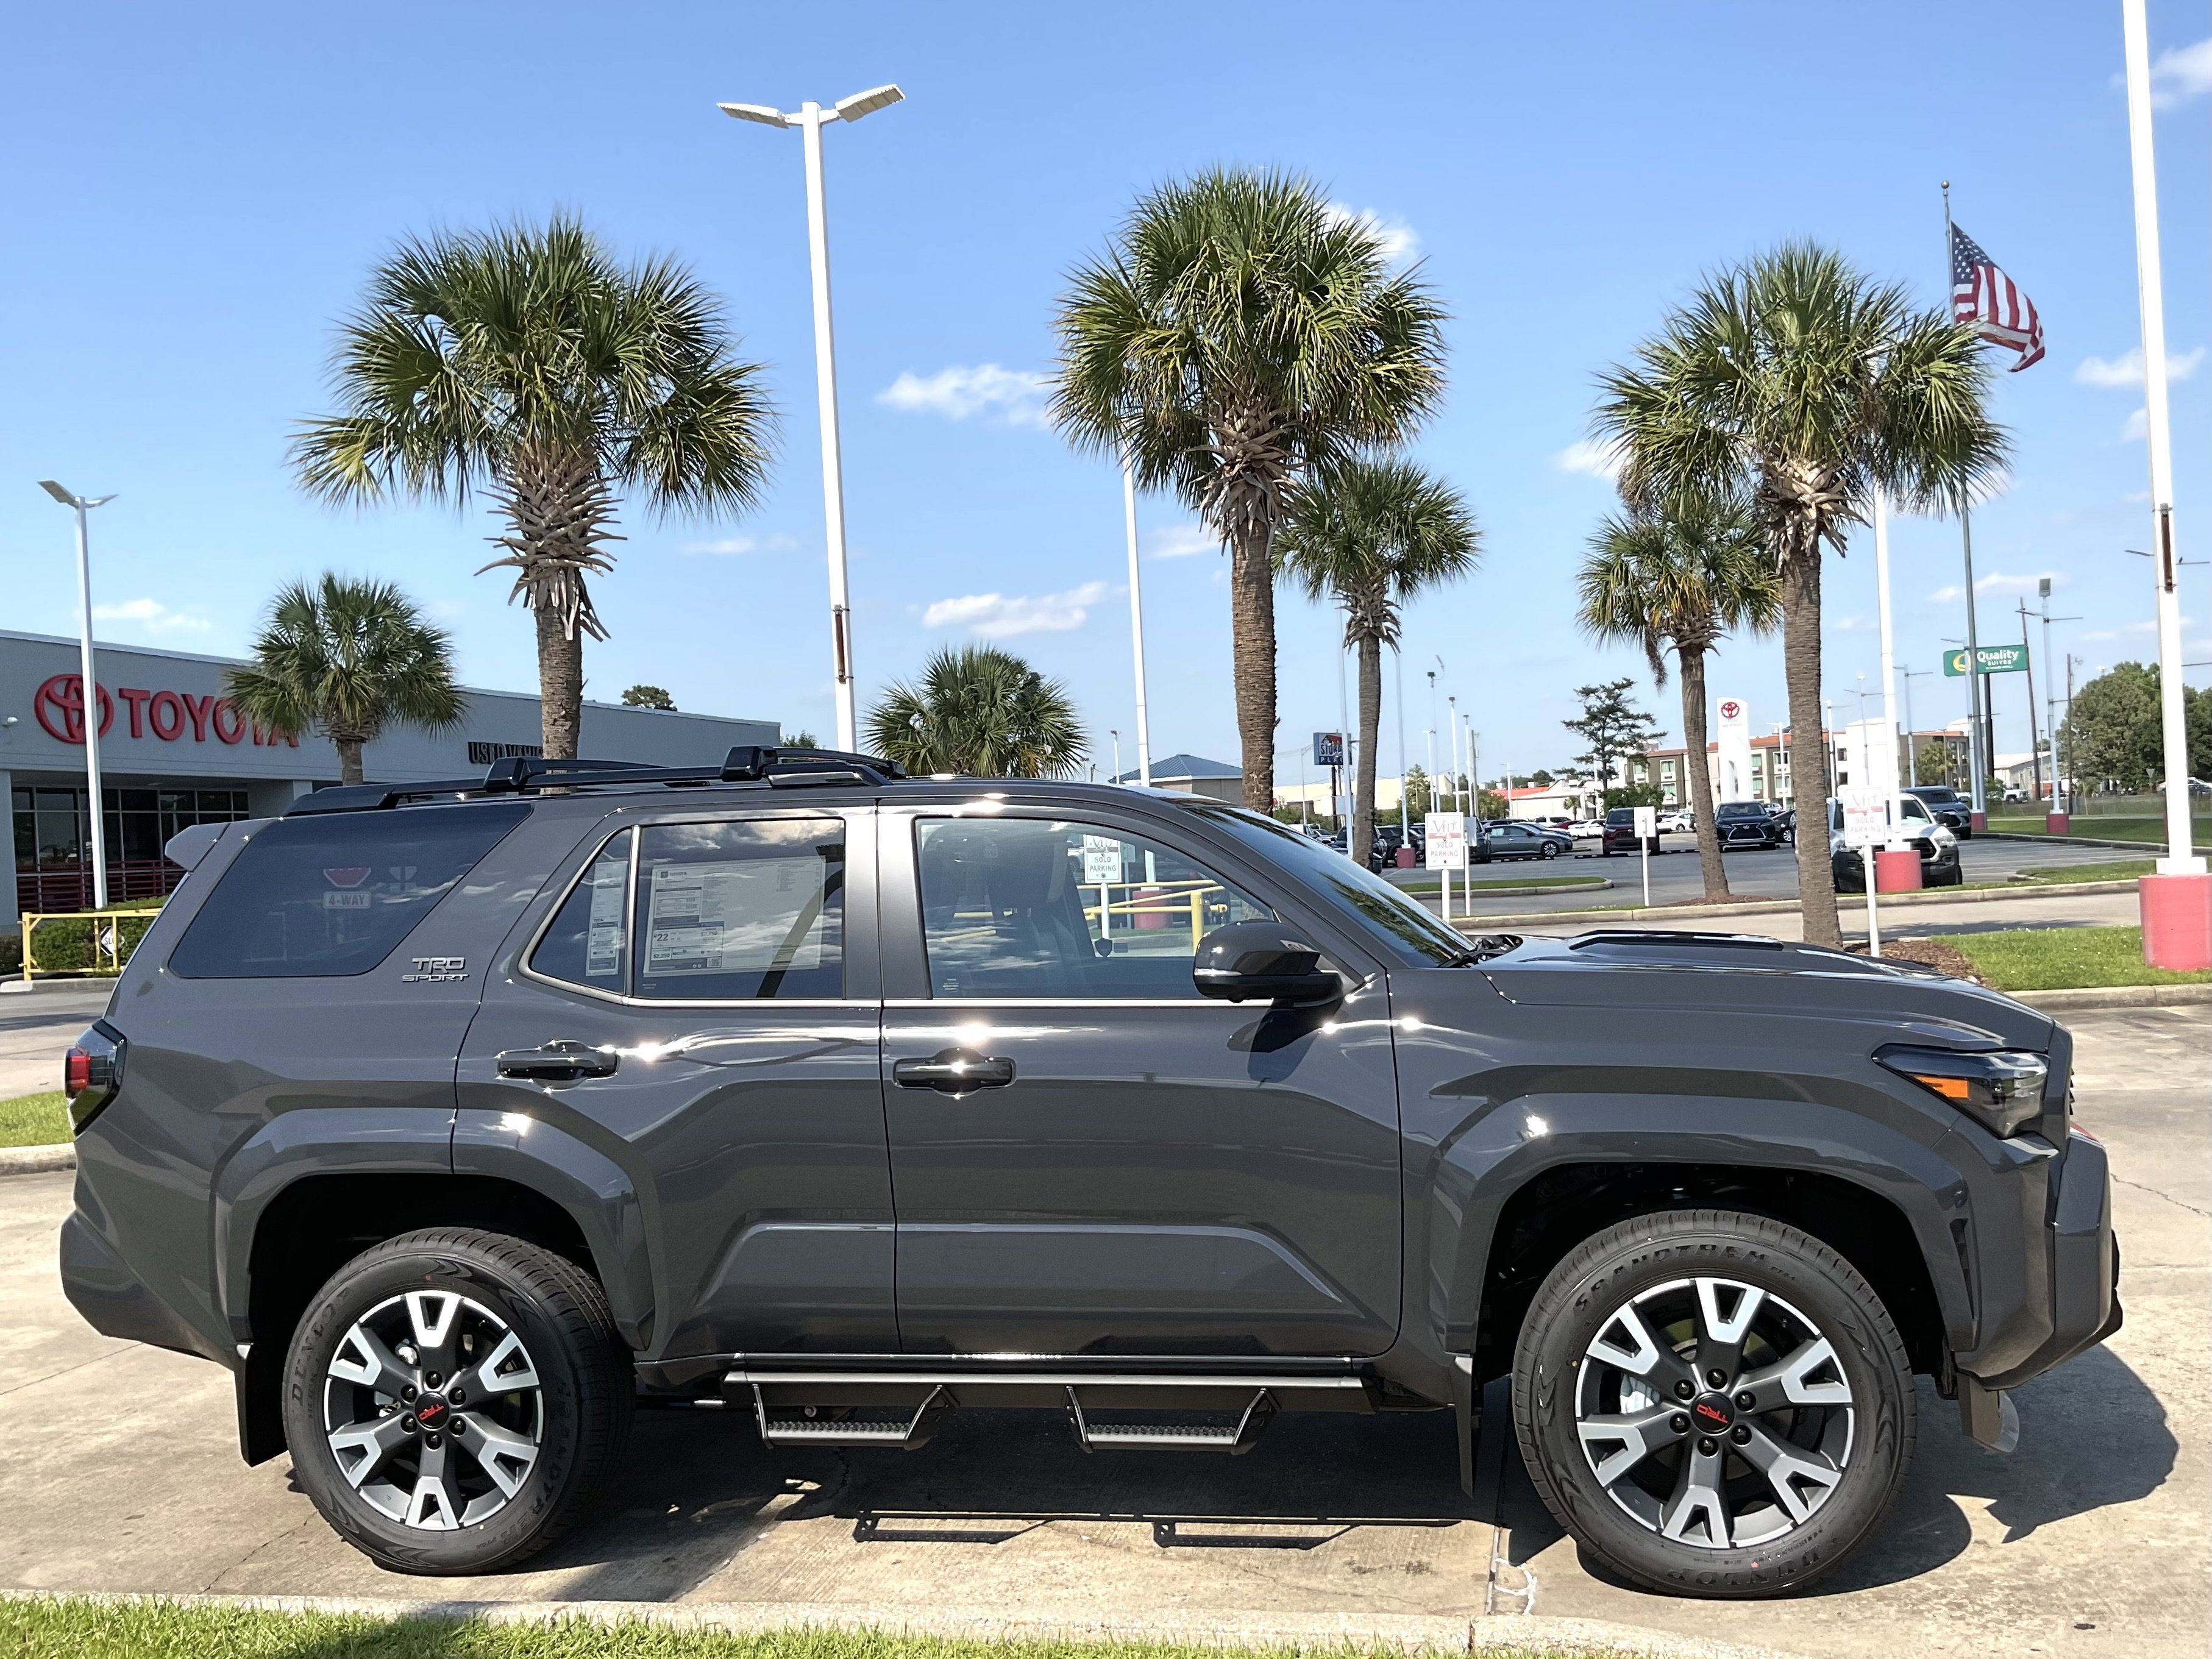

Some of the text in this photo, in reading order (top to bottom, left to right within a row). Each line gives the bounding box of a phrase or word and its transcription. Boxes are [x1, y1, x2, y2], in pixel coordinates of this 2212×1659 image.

[1977, 649, 2019, 663] Quality
[118, 687, 299, 748] TOYO
[468, 742, 505, 764] USED
[329, 894, 365, 906] 4-WAY
[656, 933, 669, 942] 22
[412, 957, 465, 974] TRD
[402, 973, 469, 982] SPORT
[292, 1287, 350, 1405] DUNLOP
[419, 1404, 444, 1420] TRD
[1696, 1404, 1729, 1424] TRD
[1667, 1545, 1822, 1586] DUNLOP
